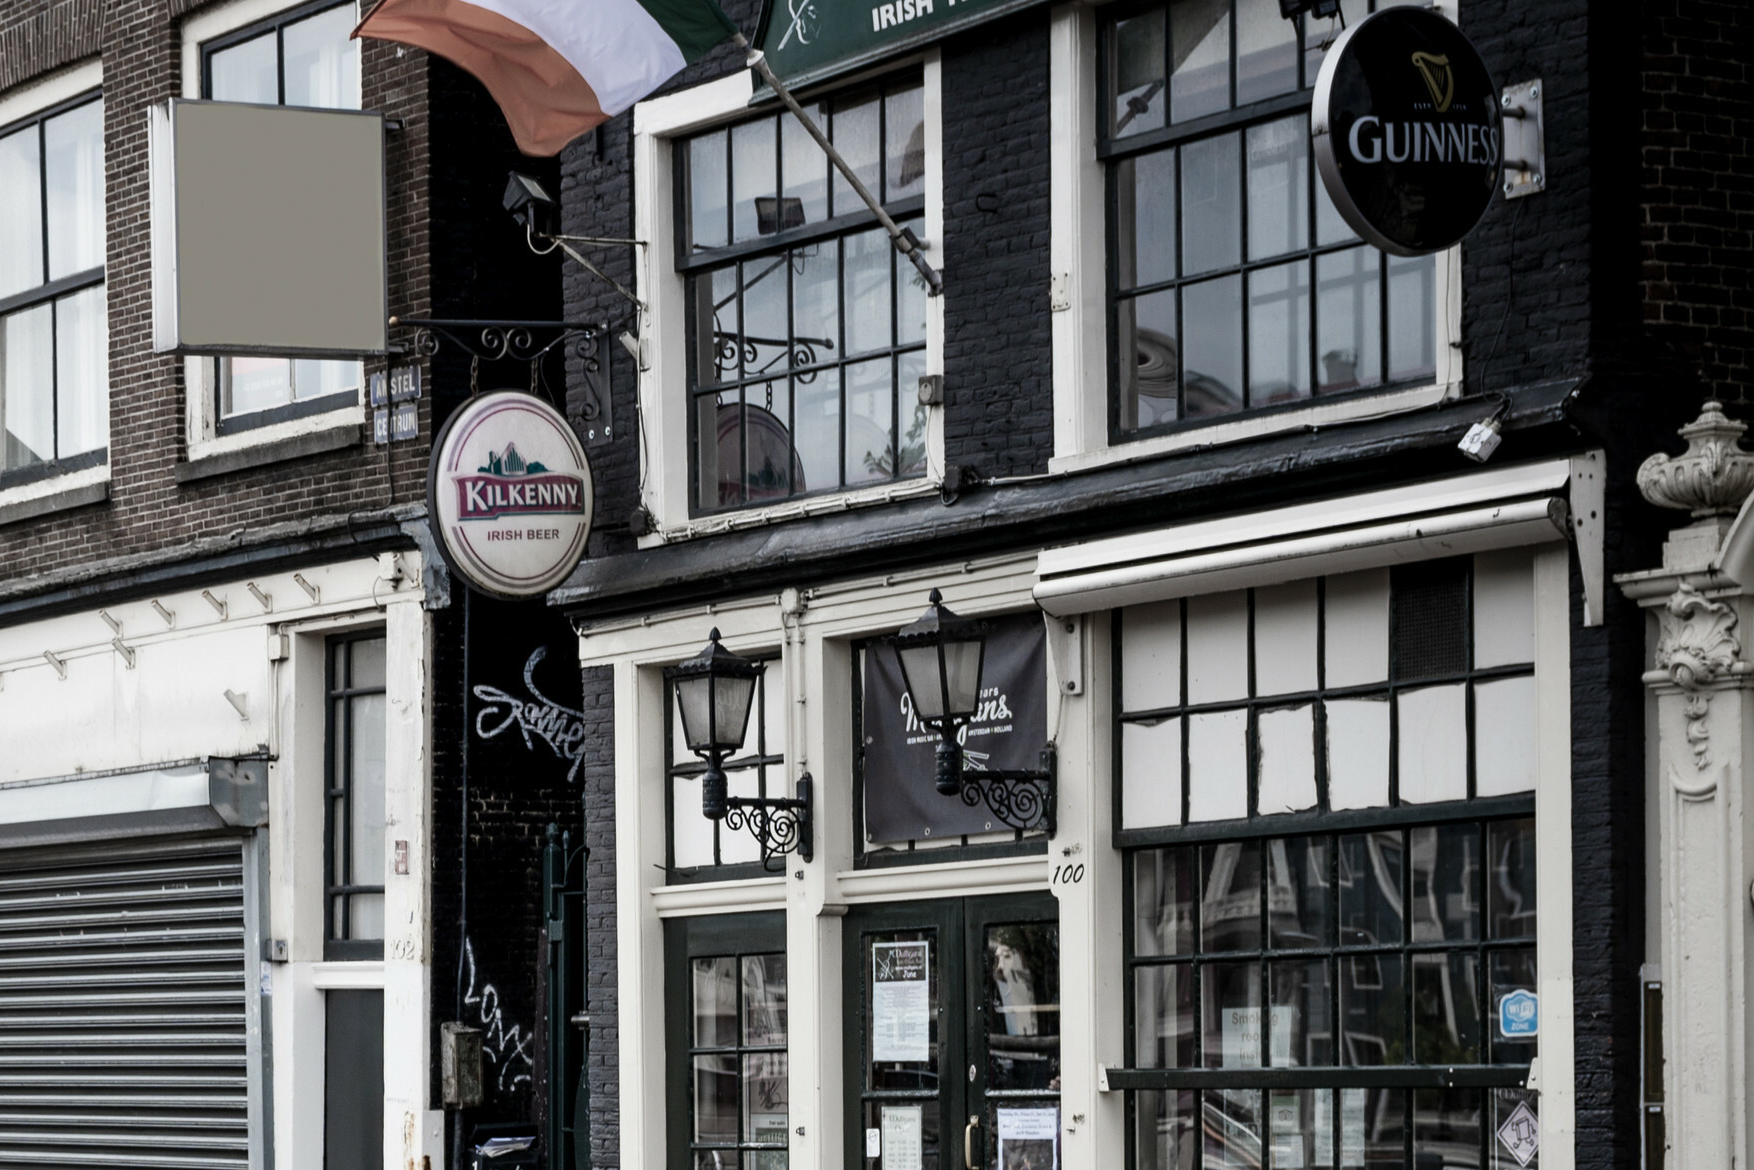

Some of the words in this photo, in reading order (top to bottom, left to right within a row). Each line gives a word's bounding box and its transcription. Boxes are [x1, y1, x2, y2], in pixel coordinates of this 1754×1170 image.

[871, 0, 935, 32] IRISH
[1348, 115, 1498, 166] GUINNESS
[376, 412, 416, 437] CETRUM
[465, 481, 578, 512] KILKENNY
[487, 530, 523, 541] IRISH
[527, 529, 560, 540] BEER
[1053, 863, 1085, 885] 100
[902, 970, 917, 979] June
[1231, 1012, 1279, 1026] Smokg
